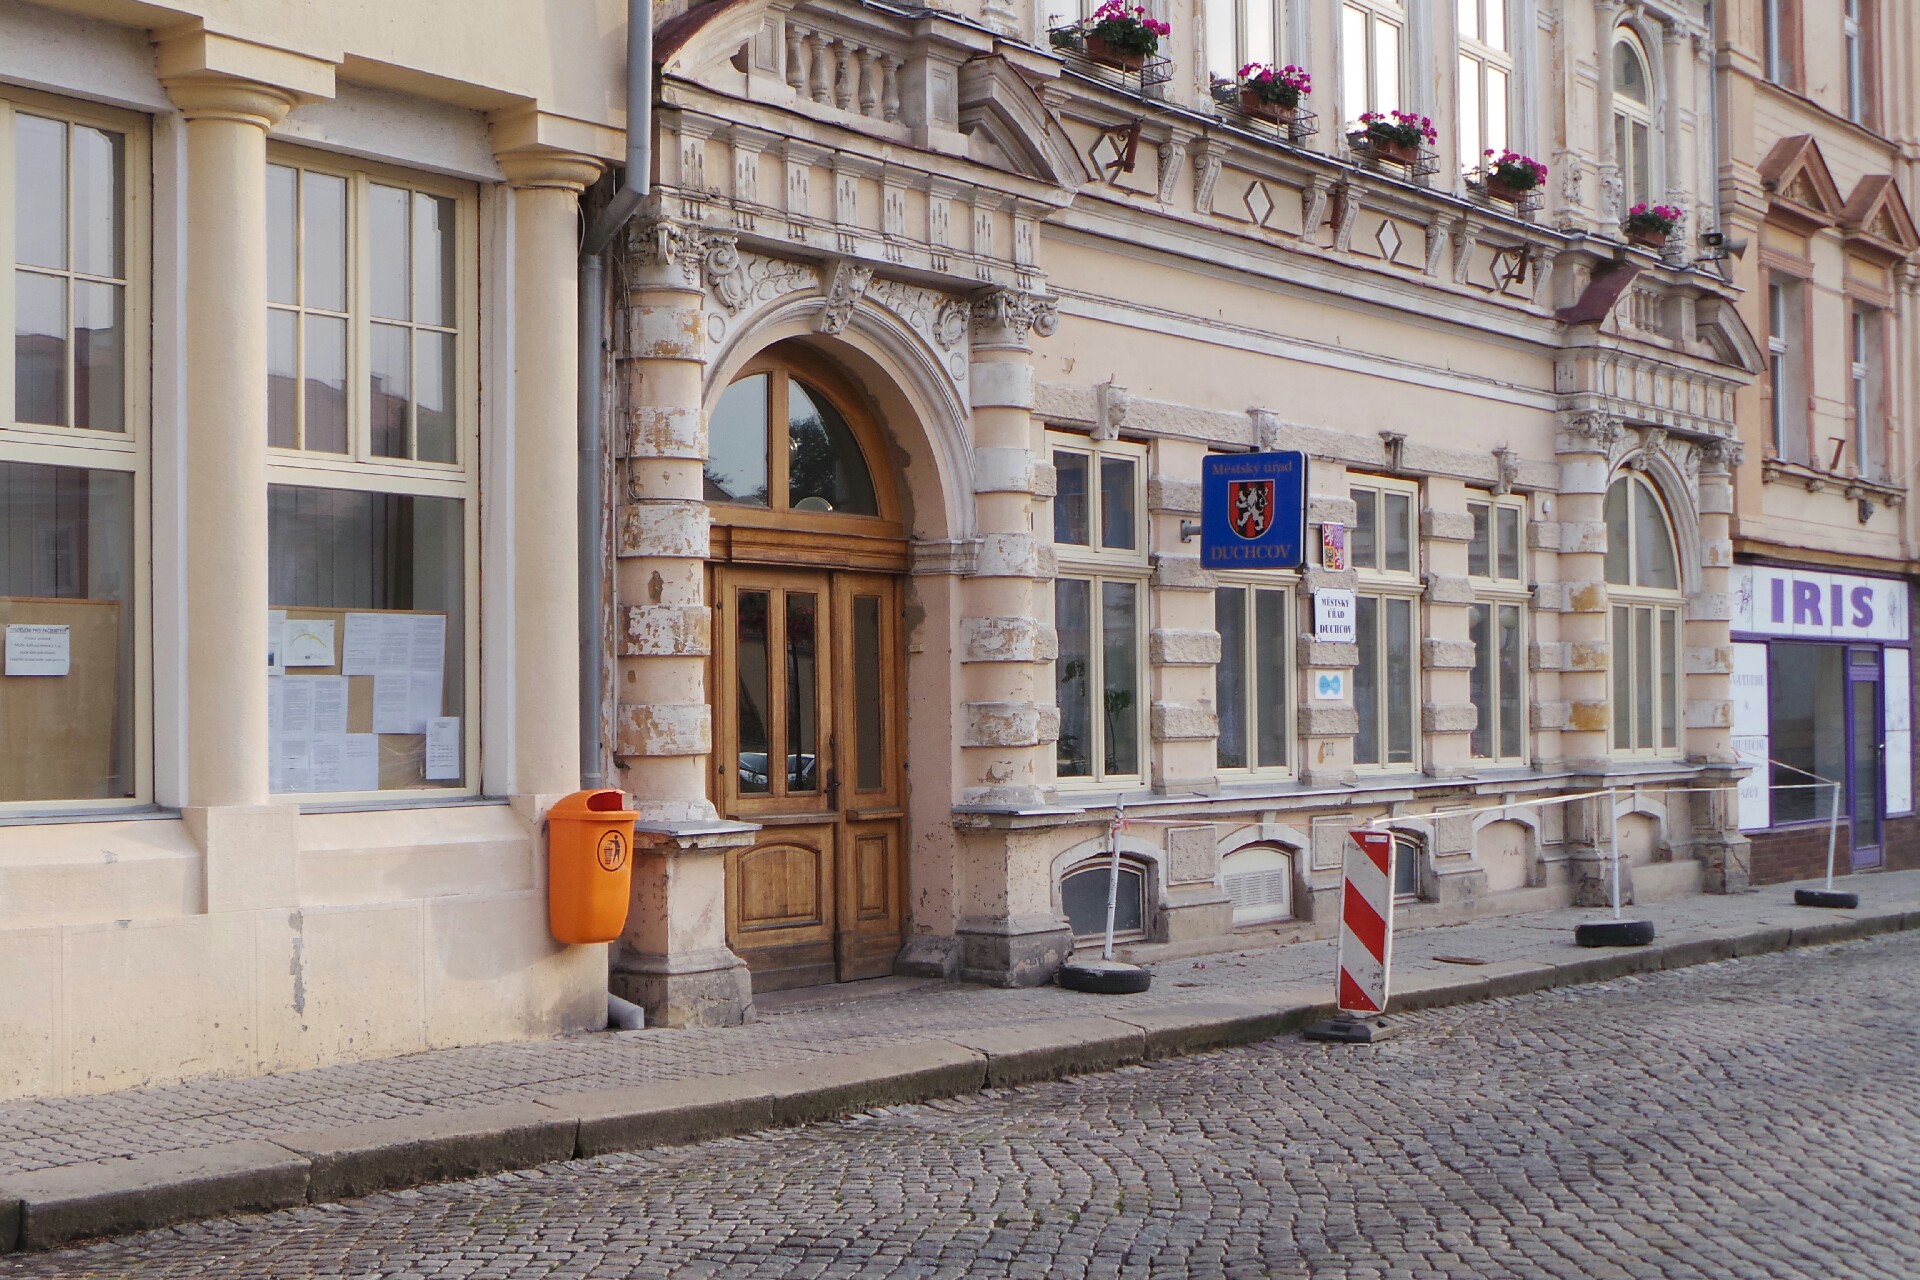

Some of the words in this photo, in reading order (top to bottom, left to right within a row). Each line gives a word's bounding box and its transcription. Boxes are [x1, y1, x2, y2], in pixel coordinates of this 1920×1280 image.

[1211, 545, 1291, 560] DUCHCOV
[1771, 578, 1874, 628] IRIS
[1327, 608, 1345, 618] ÚŘAD
[1320, 625, 1351, 634] DUCHCOV
